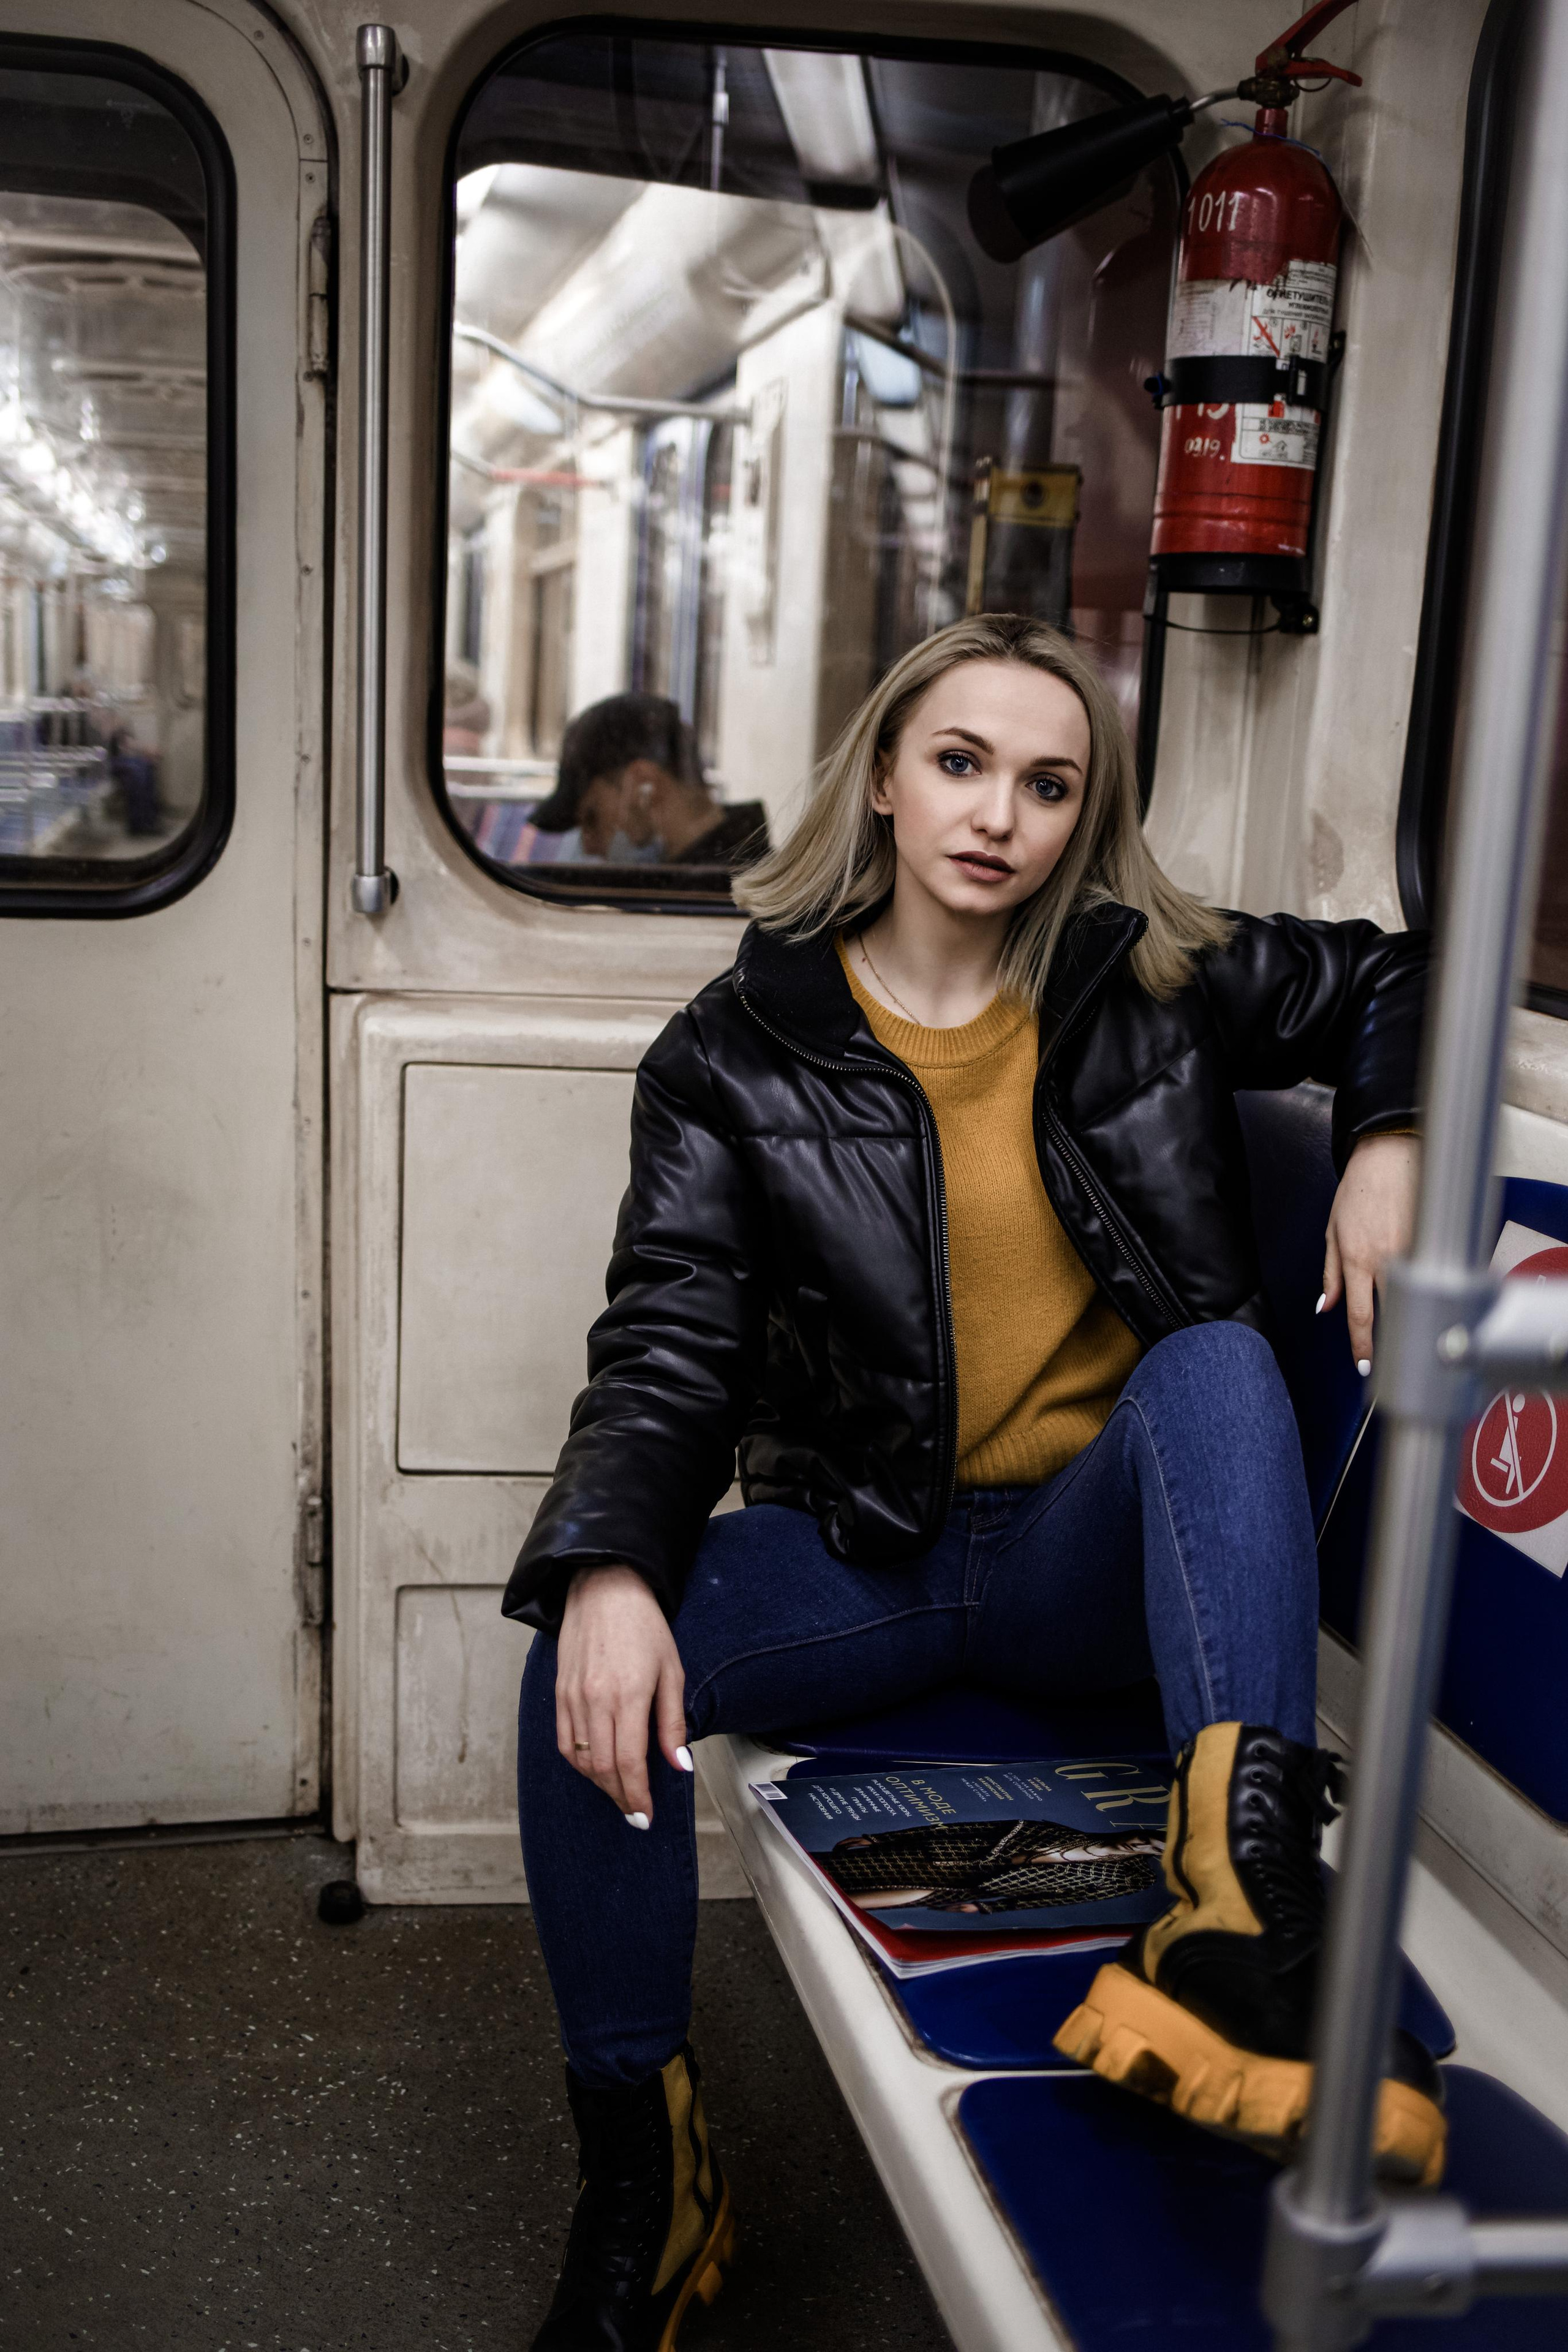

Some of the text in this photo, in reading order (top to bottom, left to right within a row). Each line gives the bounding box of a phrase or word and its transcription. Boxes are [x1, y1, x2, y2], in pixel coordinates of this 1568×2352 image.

[1188, 191, 1240, 235] 1011
[919, 1787, 957, 1815] МОДЕ
[984, 1776, 1014, 1800] КОНСТАНТИН
[809, 1793, 834, 1820] НАСТРОЕНИЯ
[821, 1792, 842, 1813] ХОРОШЕГО
[831, 1791, 848, 1805] ДРУГИЕ
[844, 1806, 862, 1820] ТРЕНДЫ
[850, 1796, 868, 1813] ПРИНТЫ
[885, 1776, 945, 1830] ОПТИМИЗМ
